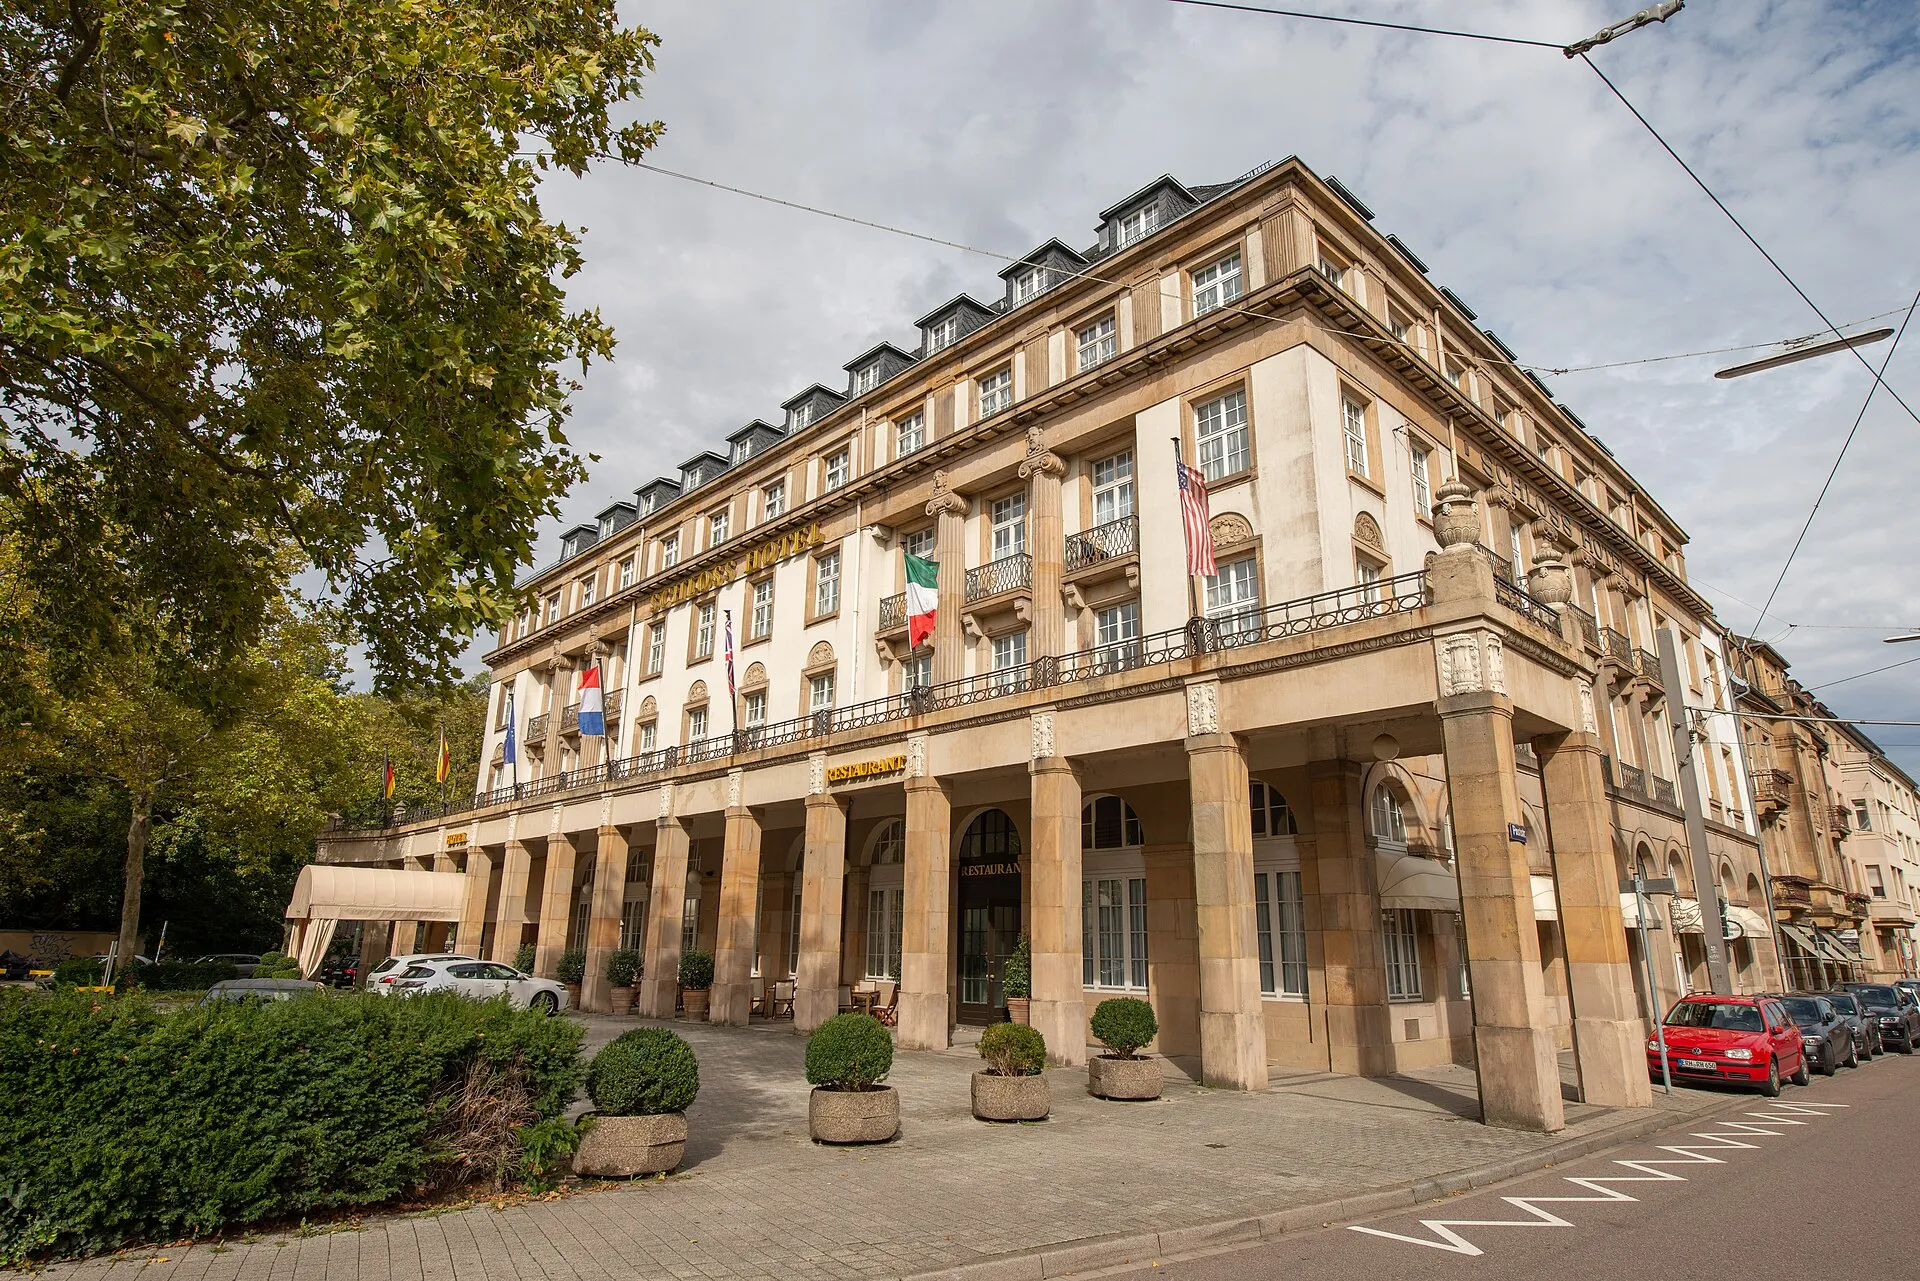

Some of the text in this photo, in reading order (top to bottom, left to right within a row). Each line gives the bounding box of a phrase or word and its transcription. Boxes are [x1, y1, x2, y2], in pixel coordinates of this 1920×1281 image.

[1480, 452, 1630, 582] SCHLOSS HOTEL
[650, 520, 826, 614] SCHLOSS HOTEL
[826, 755, 907, 783] RESTAURANT
